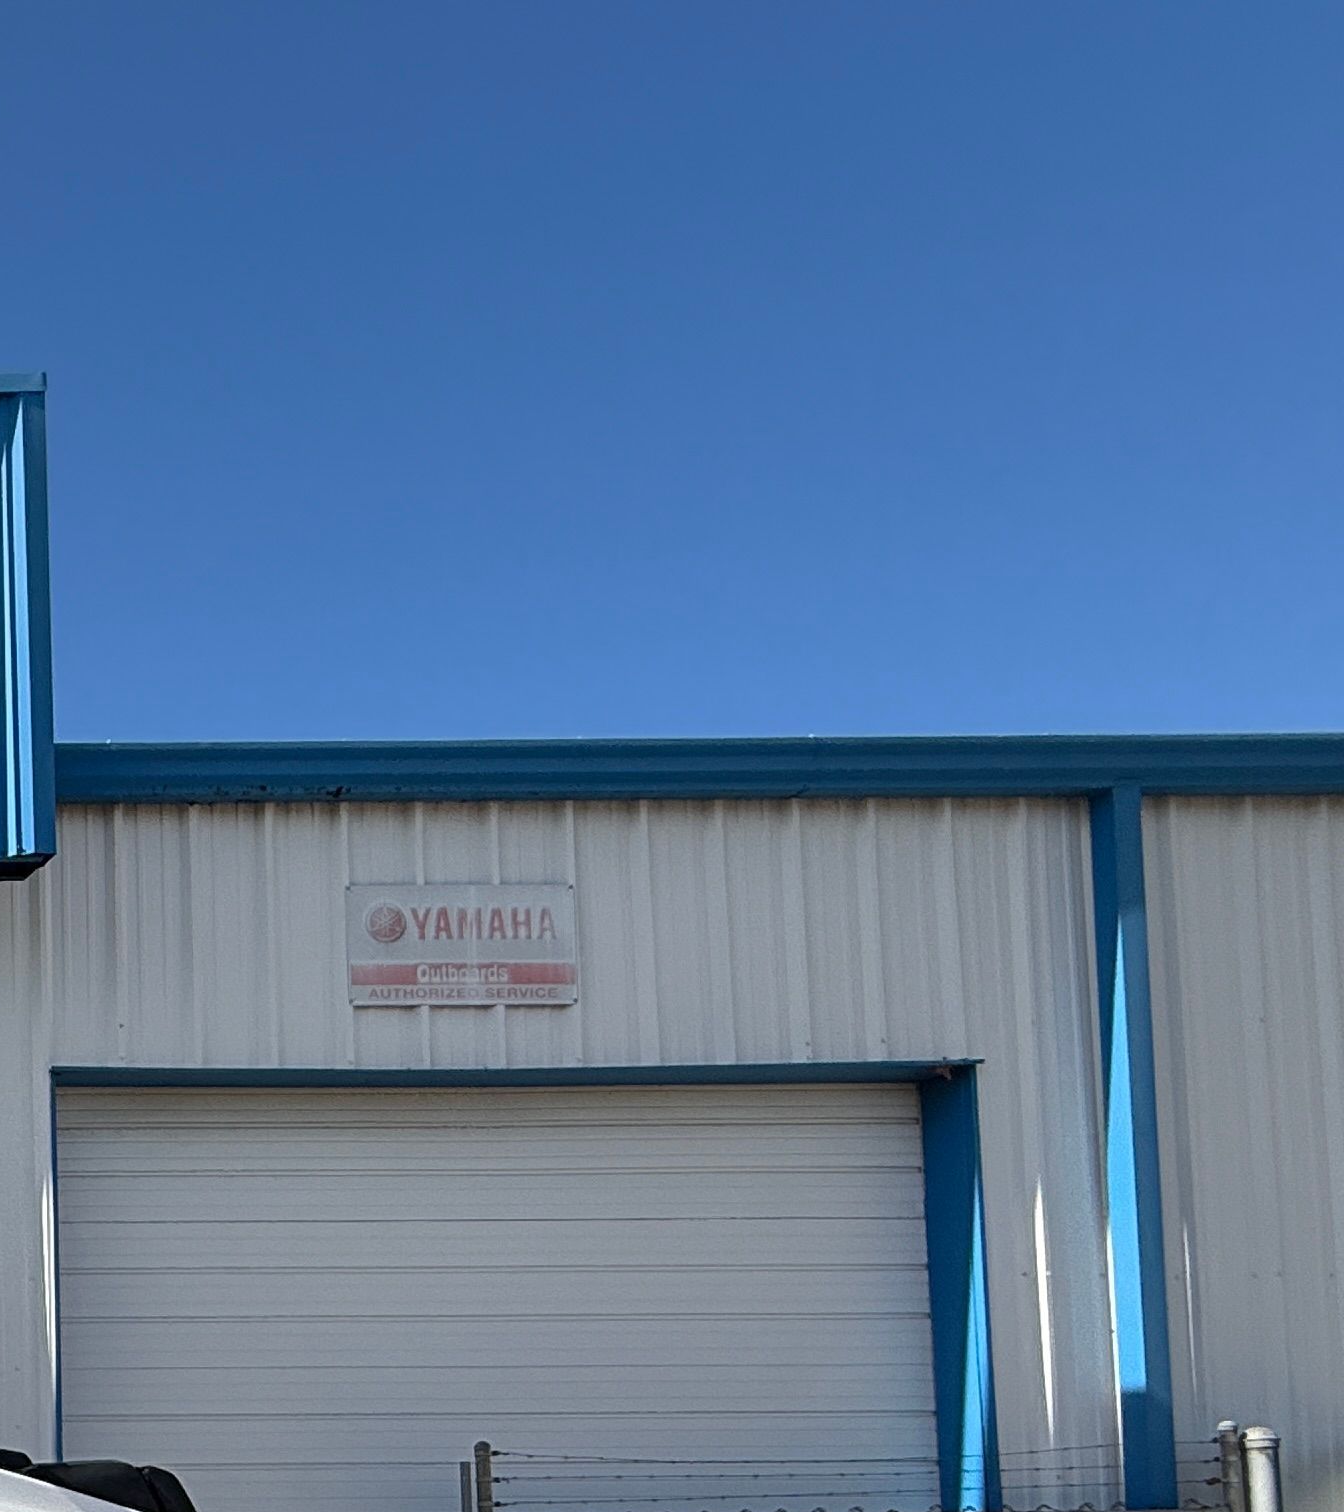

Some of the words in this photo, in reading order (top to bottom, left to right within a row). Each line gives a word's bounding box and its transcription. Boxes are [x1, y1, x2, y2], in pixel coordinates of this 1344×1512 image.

[409, 905, 557, 940] YAMAHA
[416, 963, 508, 982] Outboards
[368, 986, 480, 999] AUTHORIZED
[485, 985, 558, 999] SERVICE
